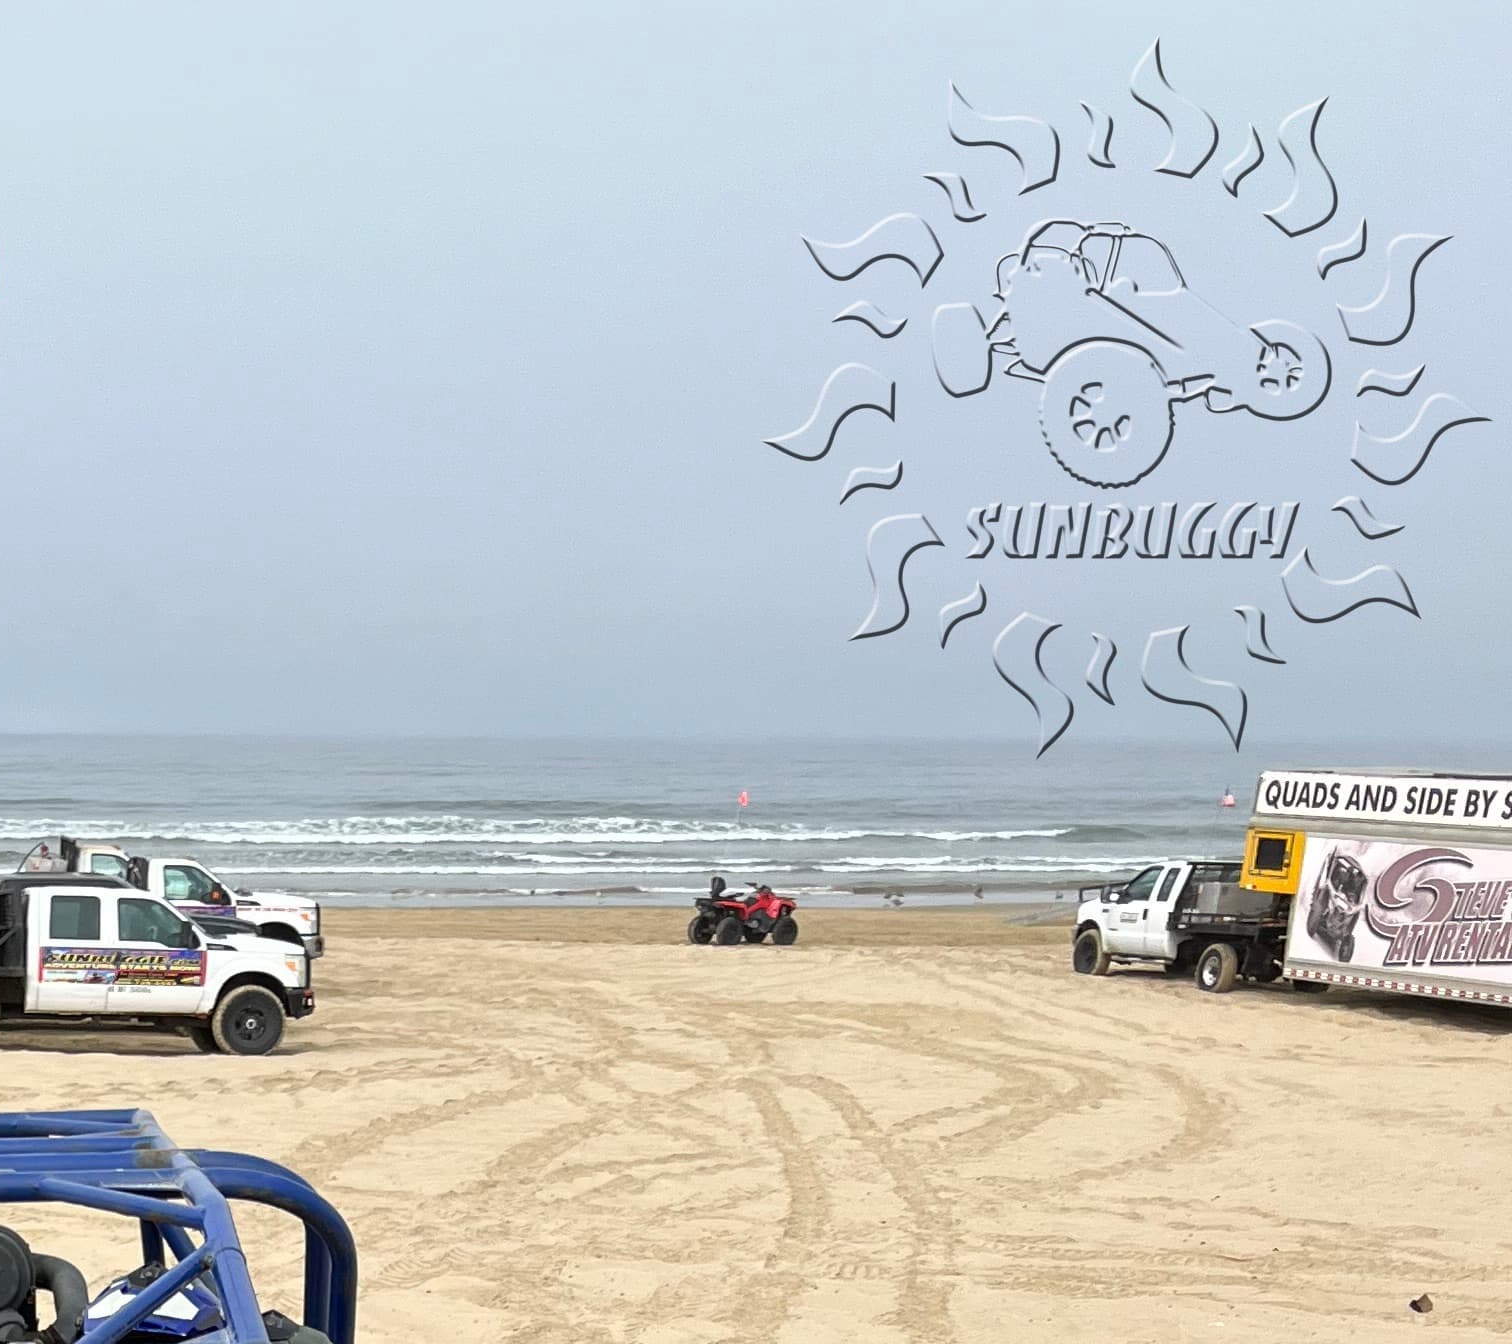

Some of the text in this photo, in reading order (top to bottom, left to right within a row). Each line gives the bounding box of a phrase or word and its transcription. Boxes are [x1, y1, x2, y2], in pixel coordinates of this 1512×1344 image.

[1265, 779, 1340, 810] QUADS
[1344, 784, 1397, 813] AND
[1403, 785, 1458, 817] SIDE
[1463, 789, 1498, 818] BY
[1383, 922, 1440, 967] ATV
